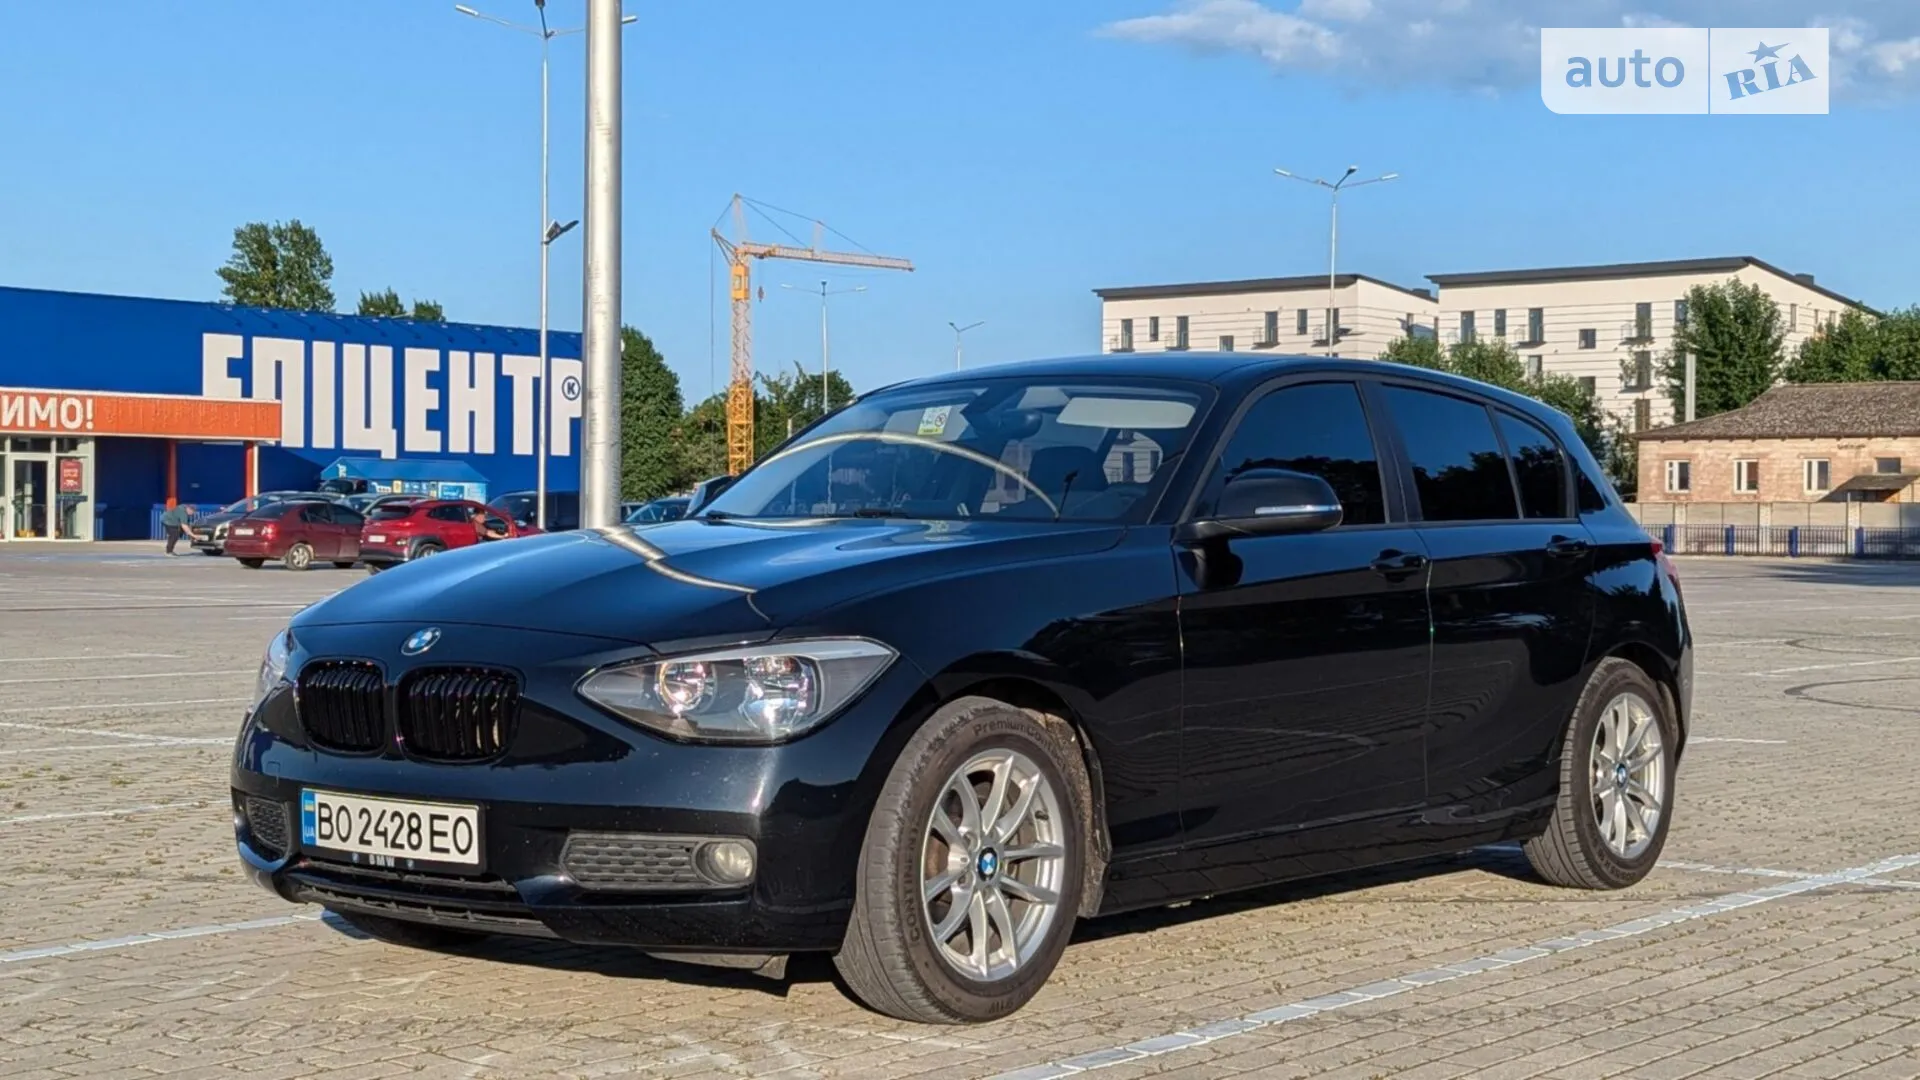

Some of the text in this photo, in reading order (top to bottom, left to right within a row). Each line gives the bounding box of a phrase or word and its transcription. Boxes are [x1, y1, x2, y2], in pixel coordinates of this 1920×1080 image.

[203, 333, 582, 459] ЕПІЦЕНТР
[318, 802, 473, 855] BO 2428 EO
